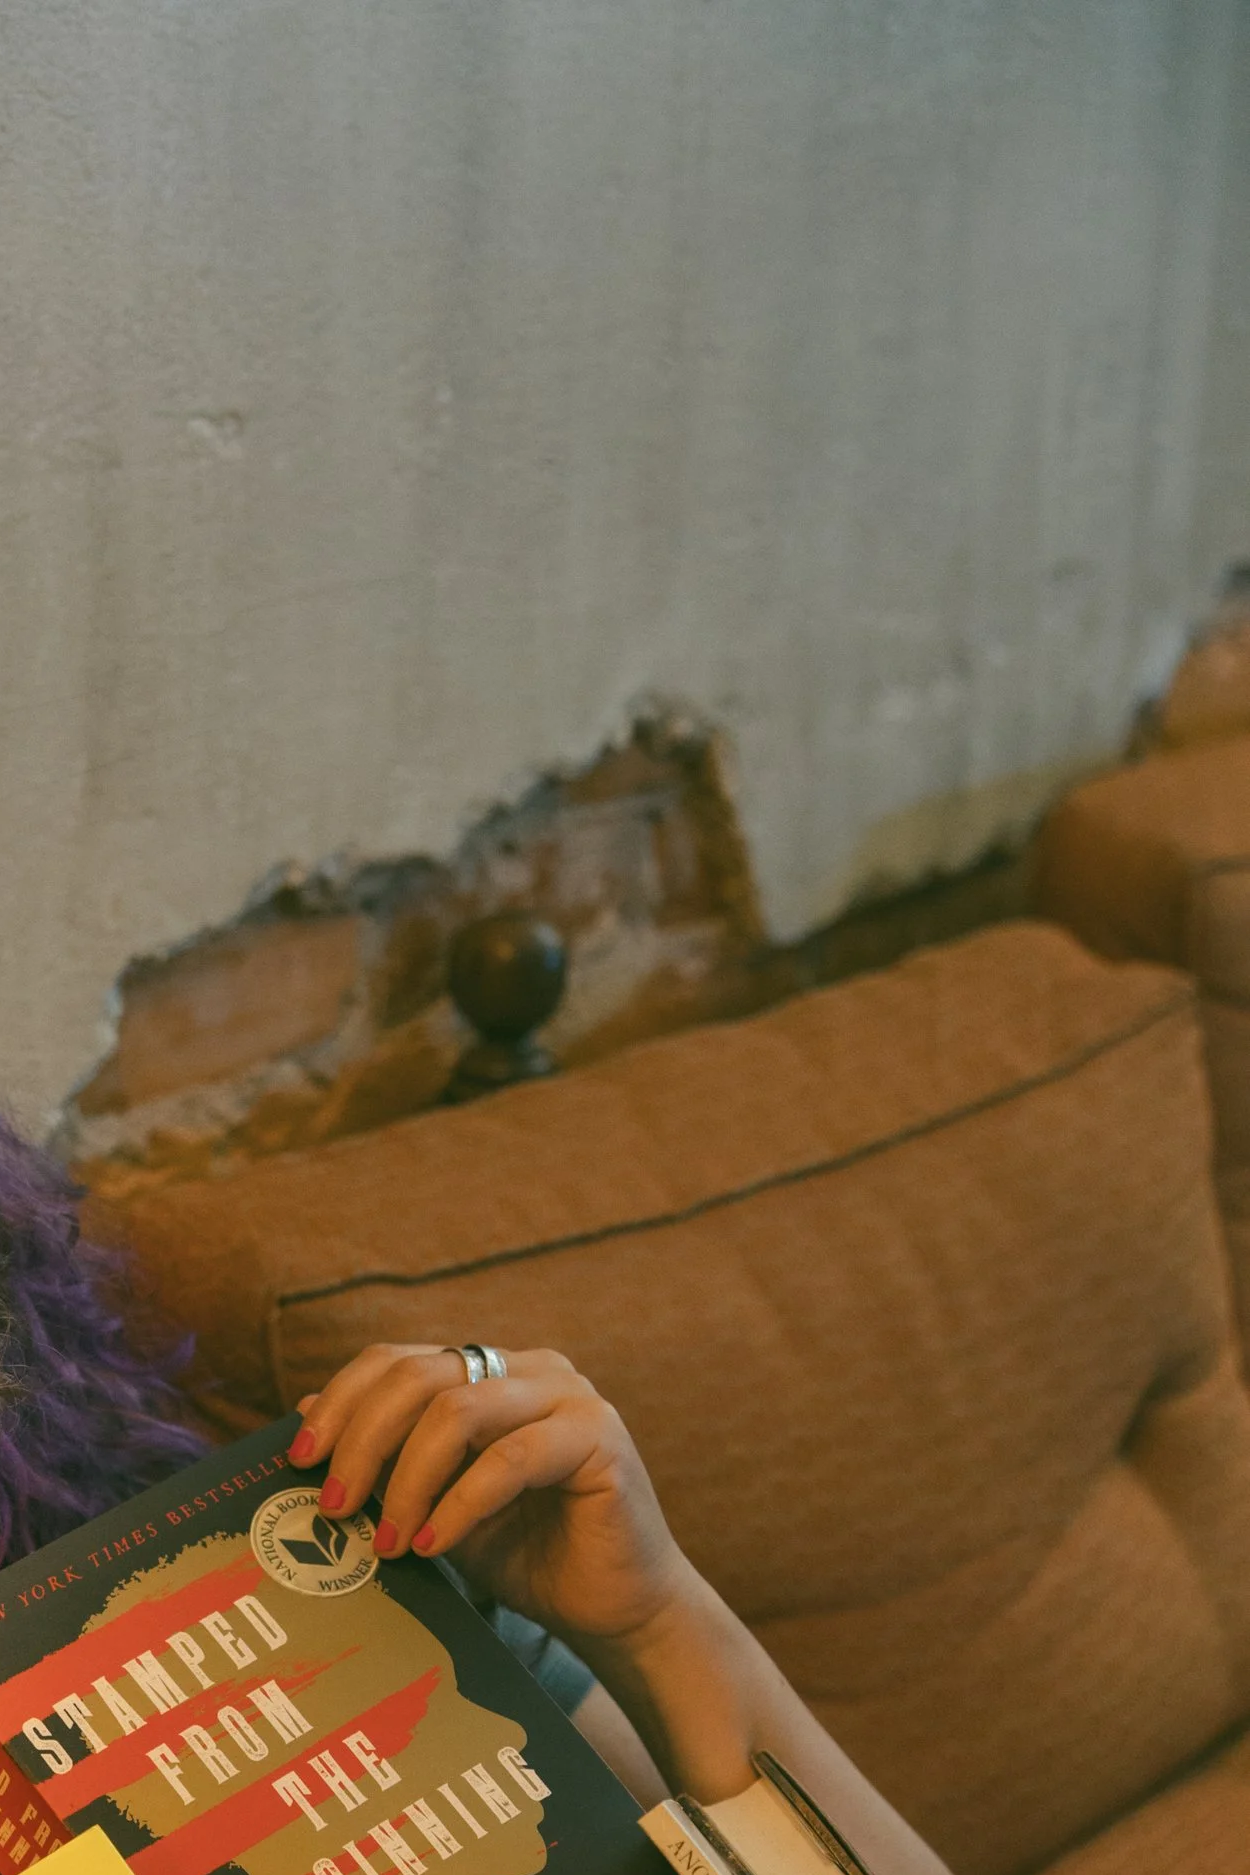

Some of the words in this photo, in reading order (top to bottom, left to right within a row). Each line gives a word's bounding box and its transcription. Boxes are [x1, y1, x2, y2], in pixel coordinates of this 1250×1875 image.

[18, 1566, 82, 1607] YORK
[88, 1522, 159, 1568] TIMES
[165, 1453, 288, 1526] BESTSELLE
[260, 1513, 298, 1581] NATIONAL
[276, 1493, 320, 1515] BOOK
[318, 1556, 373, 1592] WINNER
[22, 1594, 288, 1775] STAMPED
[146, 1679, 313, 1805] FROM
[272, 1730, 402, 1832] THE
